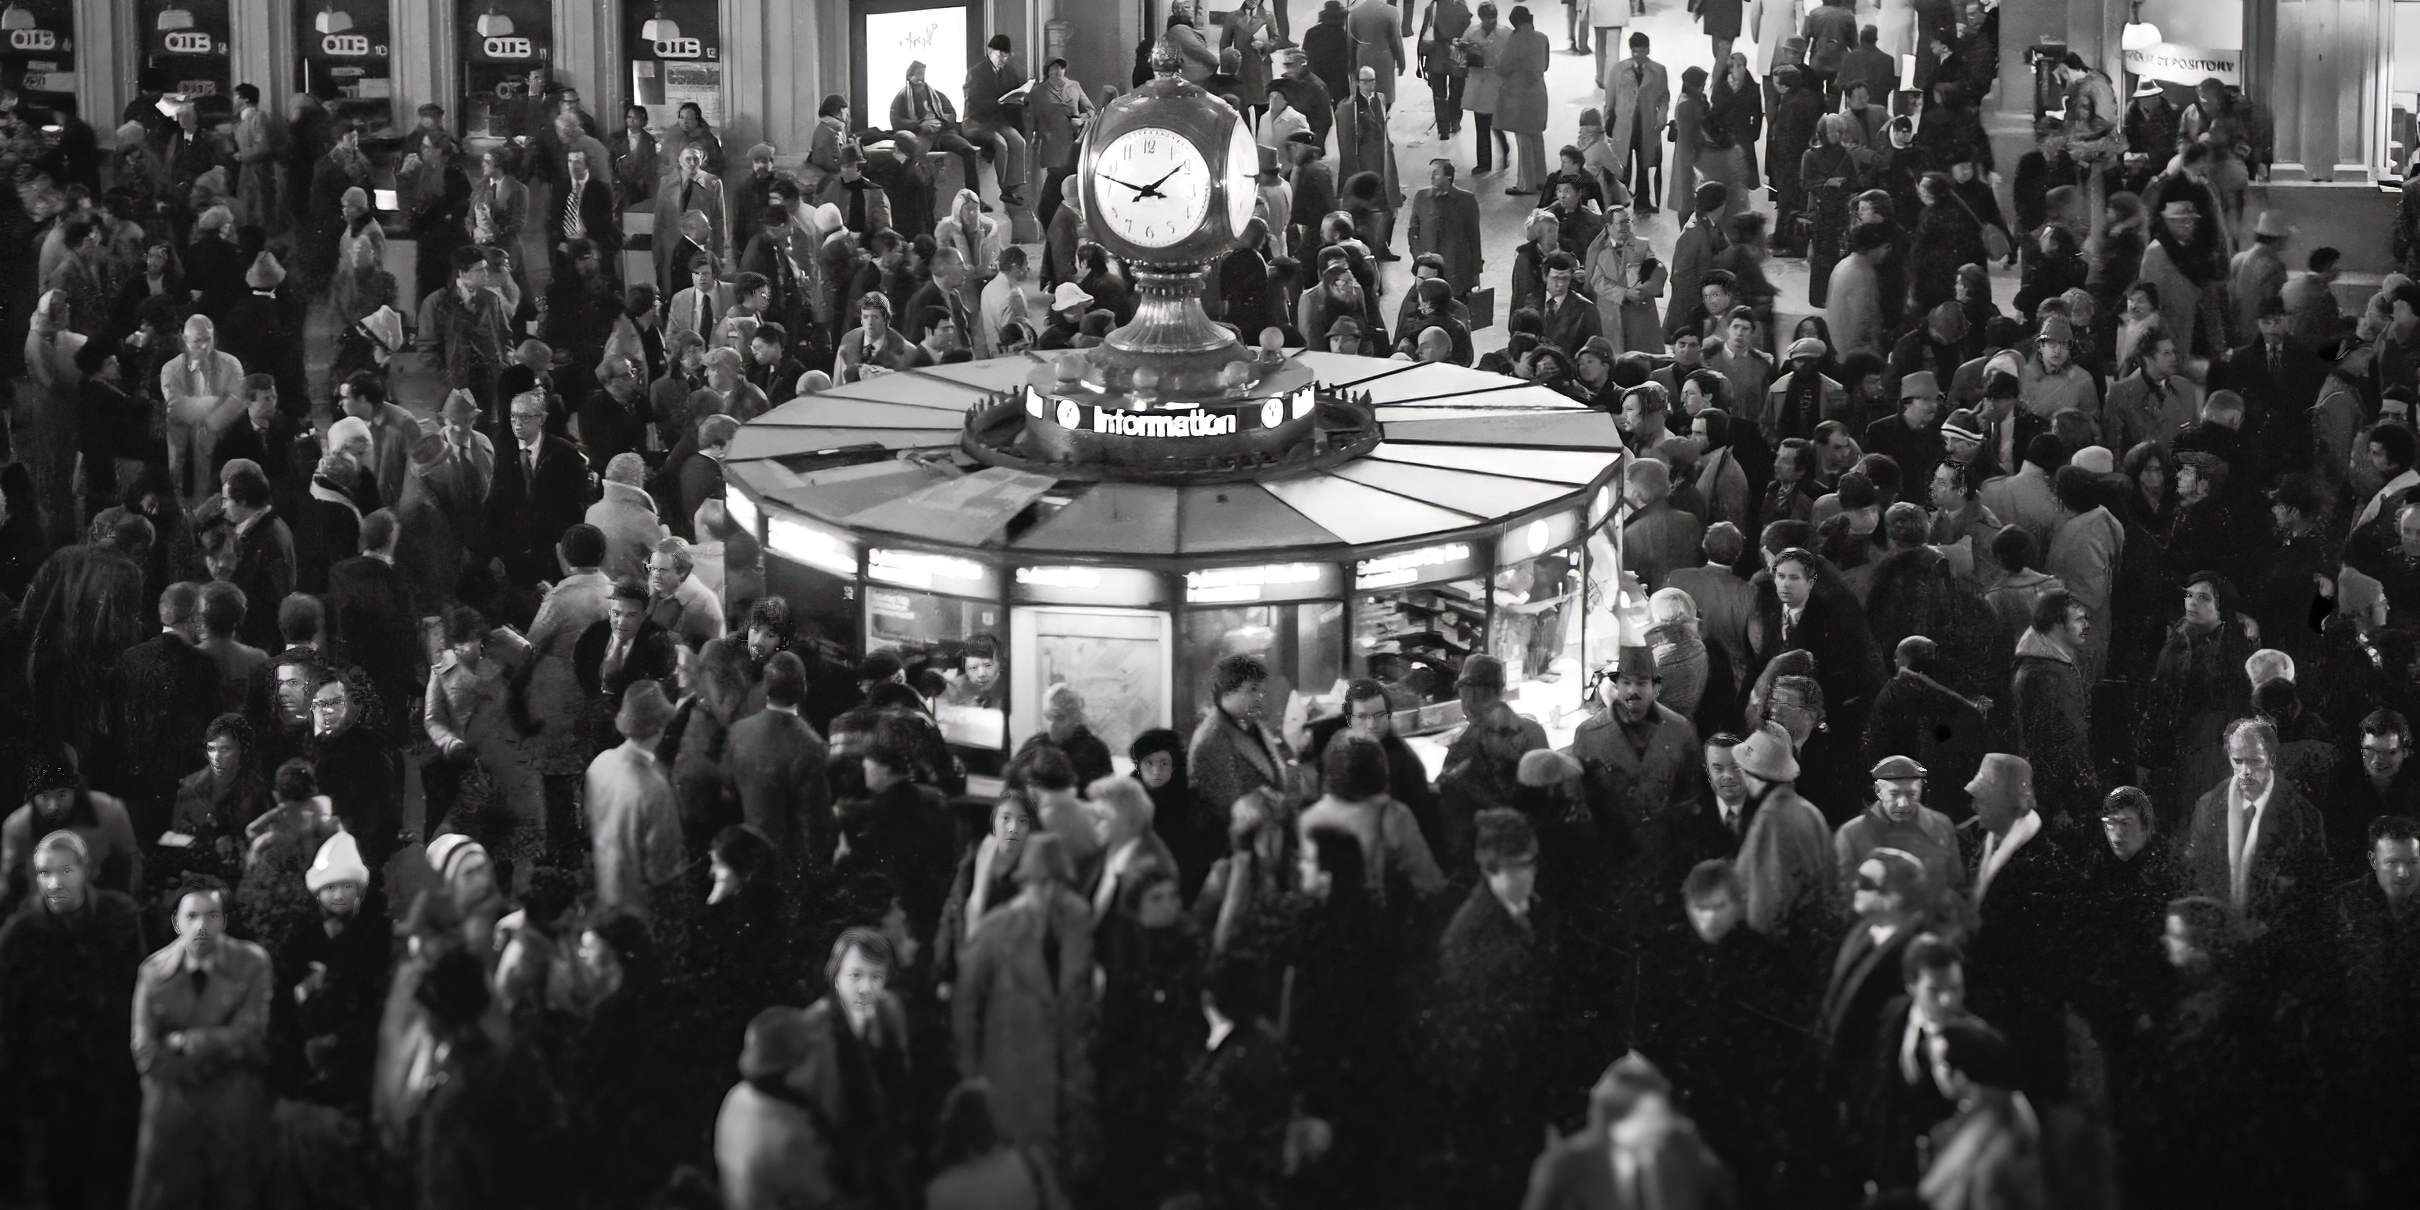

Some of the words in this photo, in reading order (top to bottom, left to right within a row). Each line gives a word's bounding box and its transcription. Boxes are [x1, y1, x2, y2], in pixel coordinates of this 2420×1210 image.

[11, 29, 55, 50] OTB
[165, 32, 211, 52] OTB
[321, 35, 369, 55] OTB
[484, 37, 531, 57] OTB
[653, 37, 701, 57] OTB
[1094, 405, 1236, 437] Information
